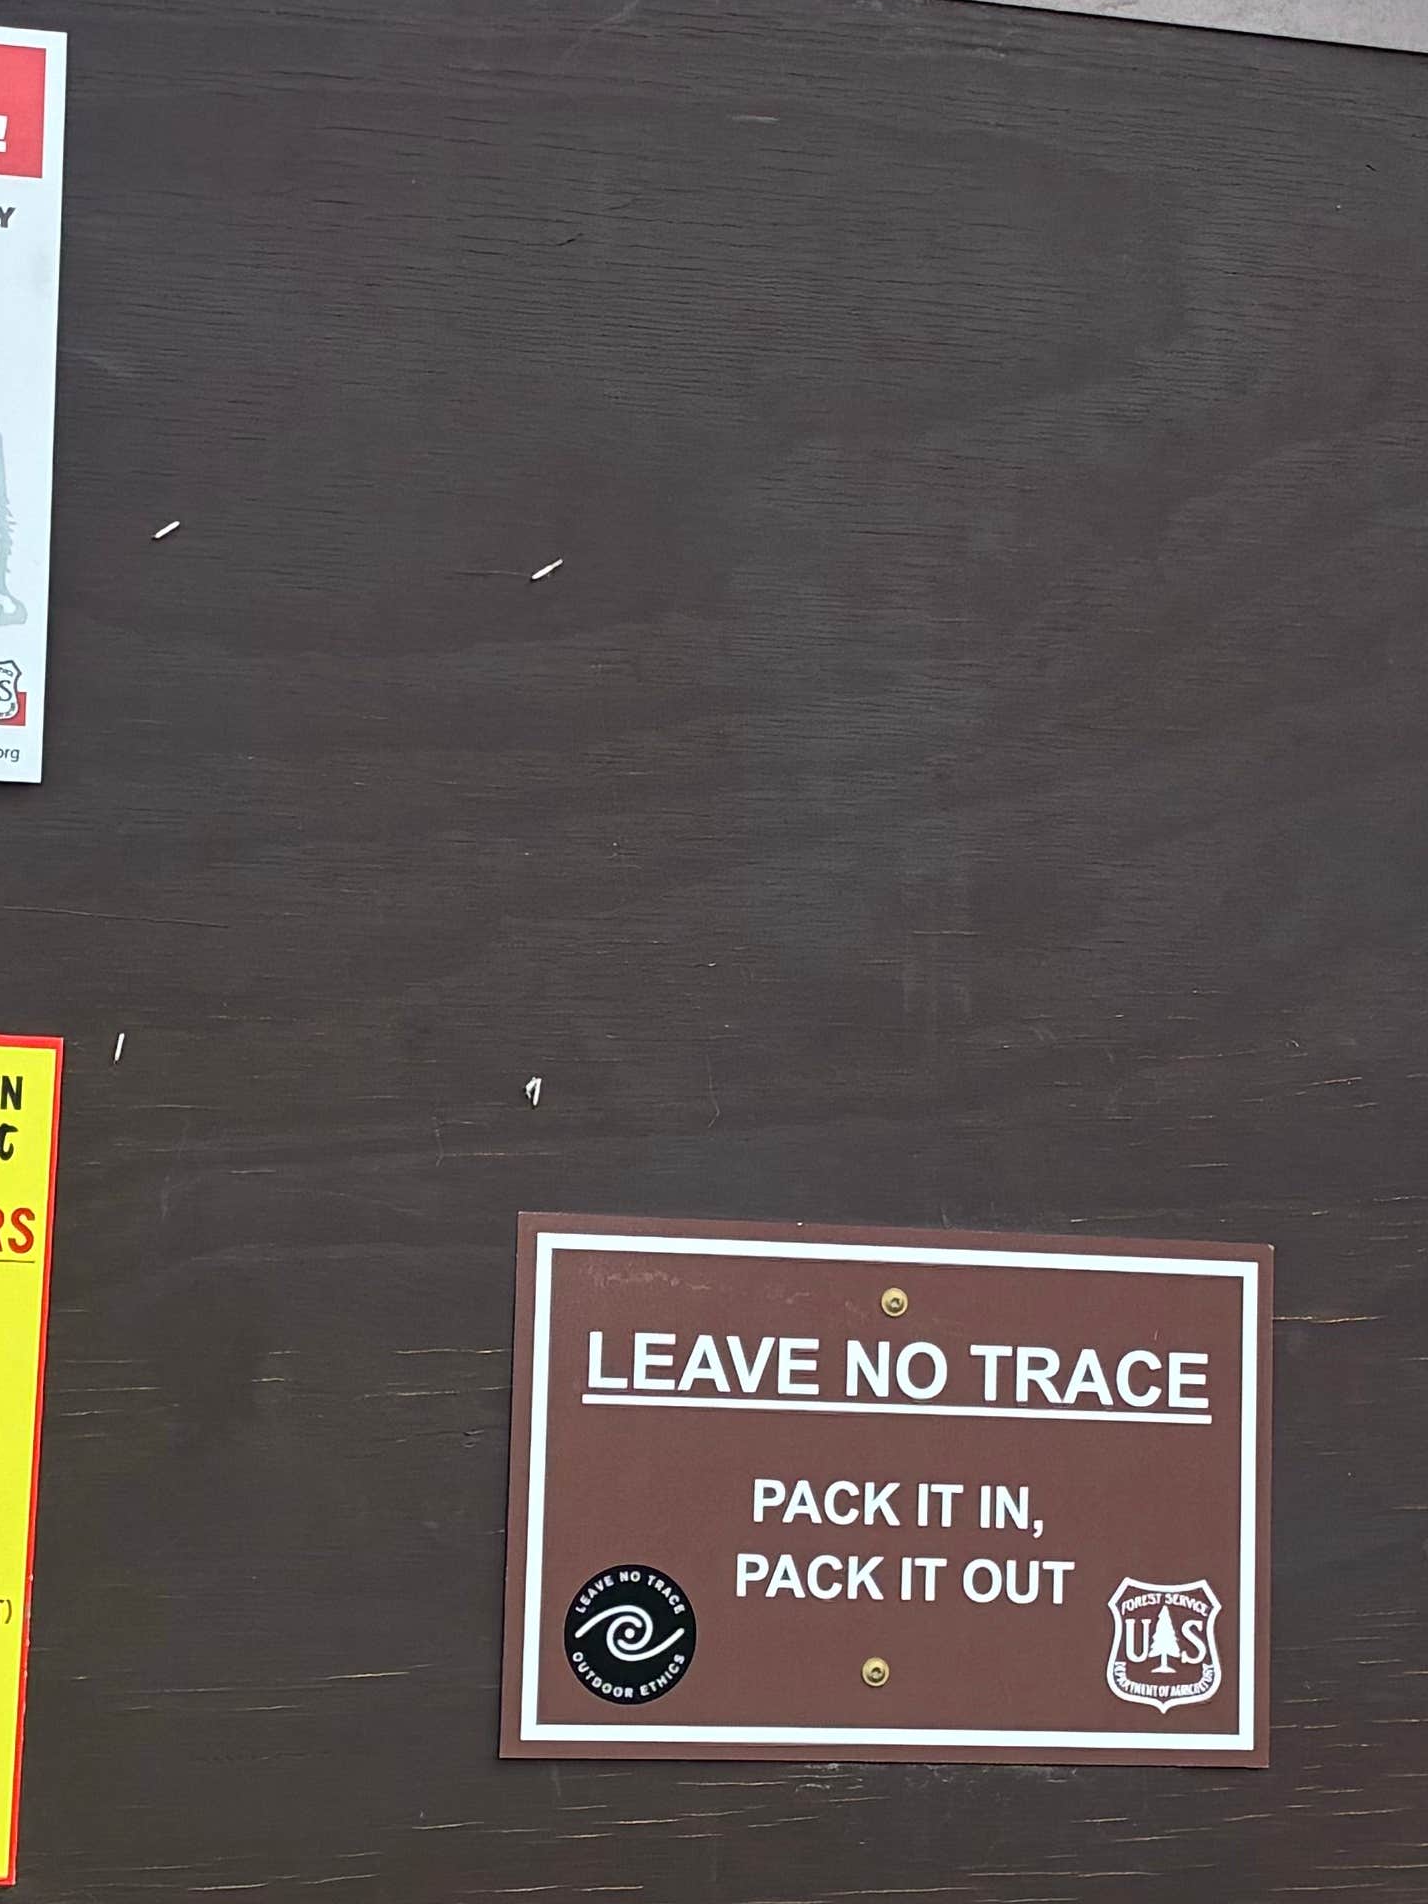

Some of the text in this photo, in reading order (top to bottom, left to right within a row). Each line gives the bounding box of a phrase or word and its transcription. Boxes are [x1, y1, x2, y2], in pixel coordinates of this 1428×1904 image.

[588, 1331, 1209, 1409] LEAVE NO TRACE
[753, 1479, 1043, 1538] PACK IT IN,
[575, 1571, 685, 1614] LEAVE NO TRACE
[736, 1553, 1075, 1604] PACK IT OUT
[572, 1651, 685, 1698] OUTDOOR ETHICS
